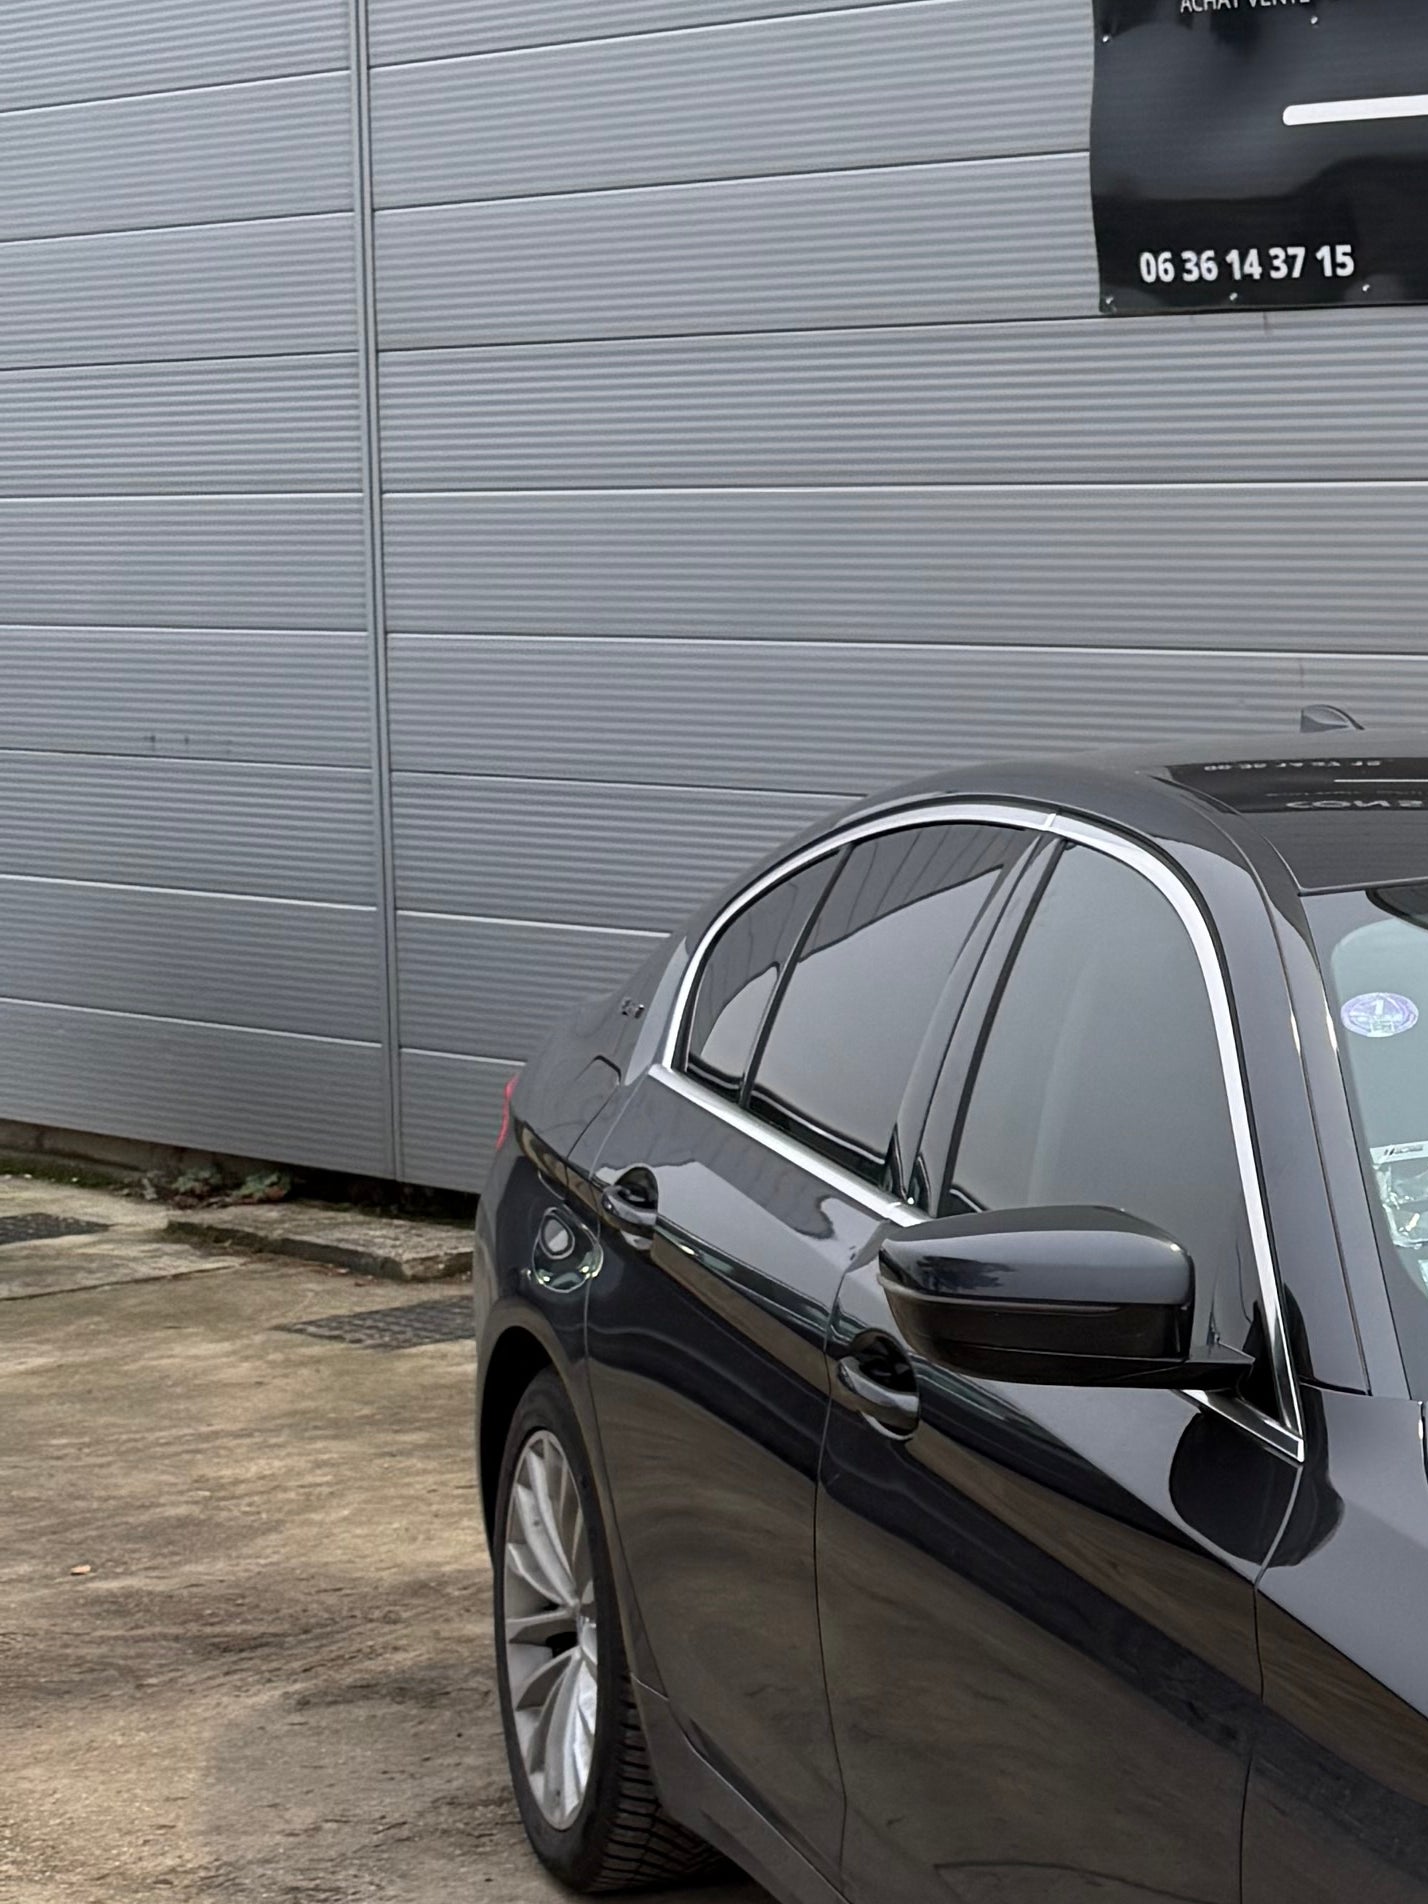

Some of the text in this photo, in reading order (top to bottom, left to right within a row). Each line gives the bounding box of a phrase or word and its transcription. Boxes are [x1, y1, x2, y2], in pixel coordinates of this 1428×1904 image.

[1140, 244, 1355, 283] 06 36 14 37 15
